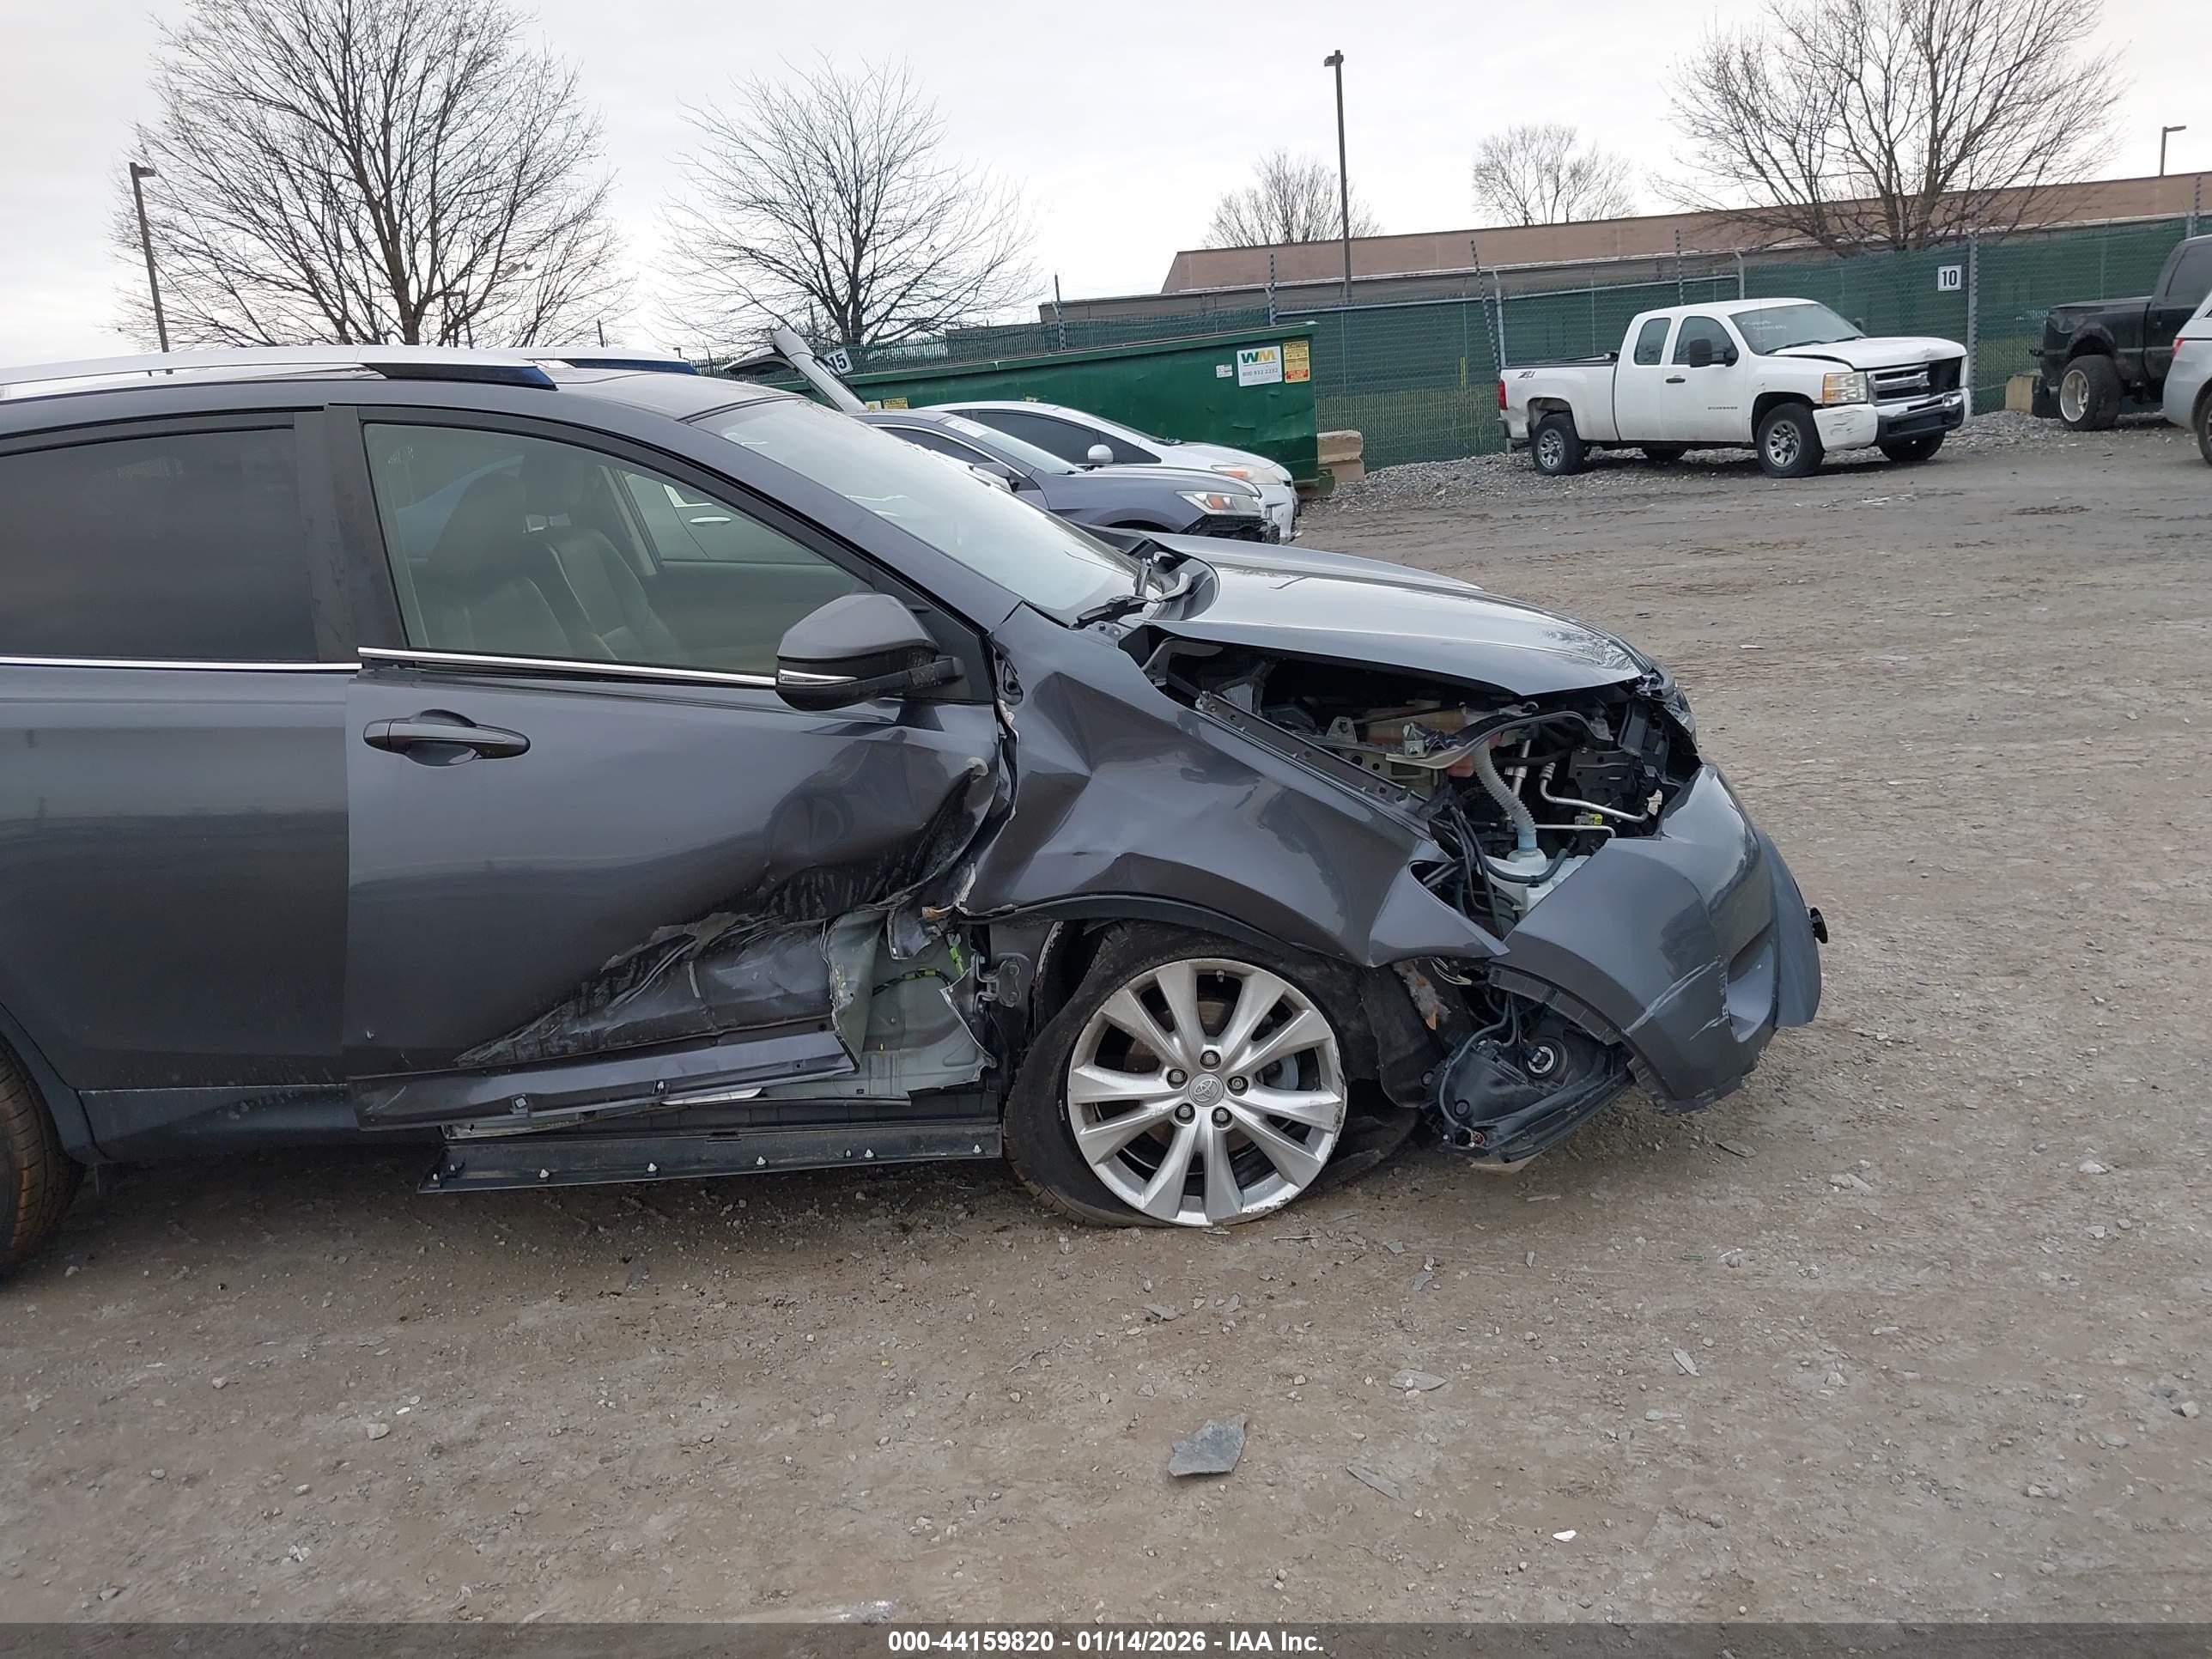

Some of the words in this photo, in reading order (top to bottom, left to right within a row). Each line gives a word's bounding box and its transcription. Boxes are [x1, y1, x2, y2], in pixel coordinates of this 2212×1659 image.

[1942, 270, 1958, 287] 10
[829, 352, 848, 372] 15
[1241, 349, 1275, 364] WM
